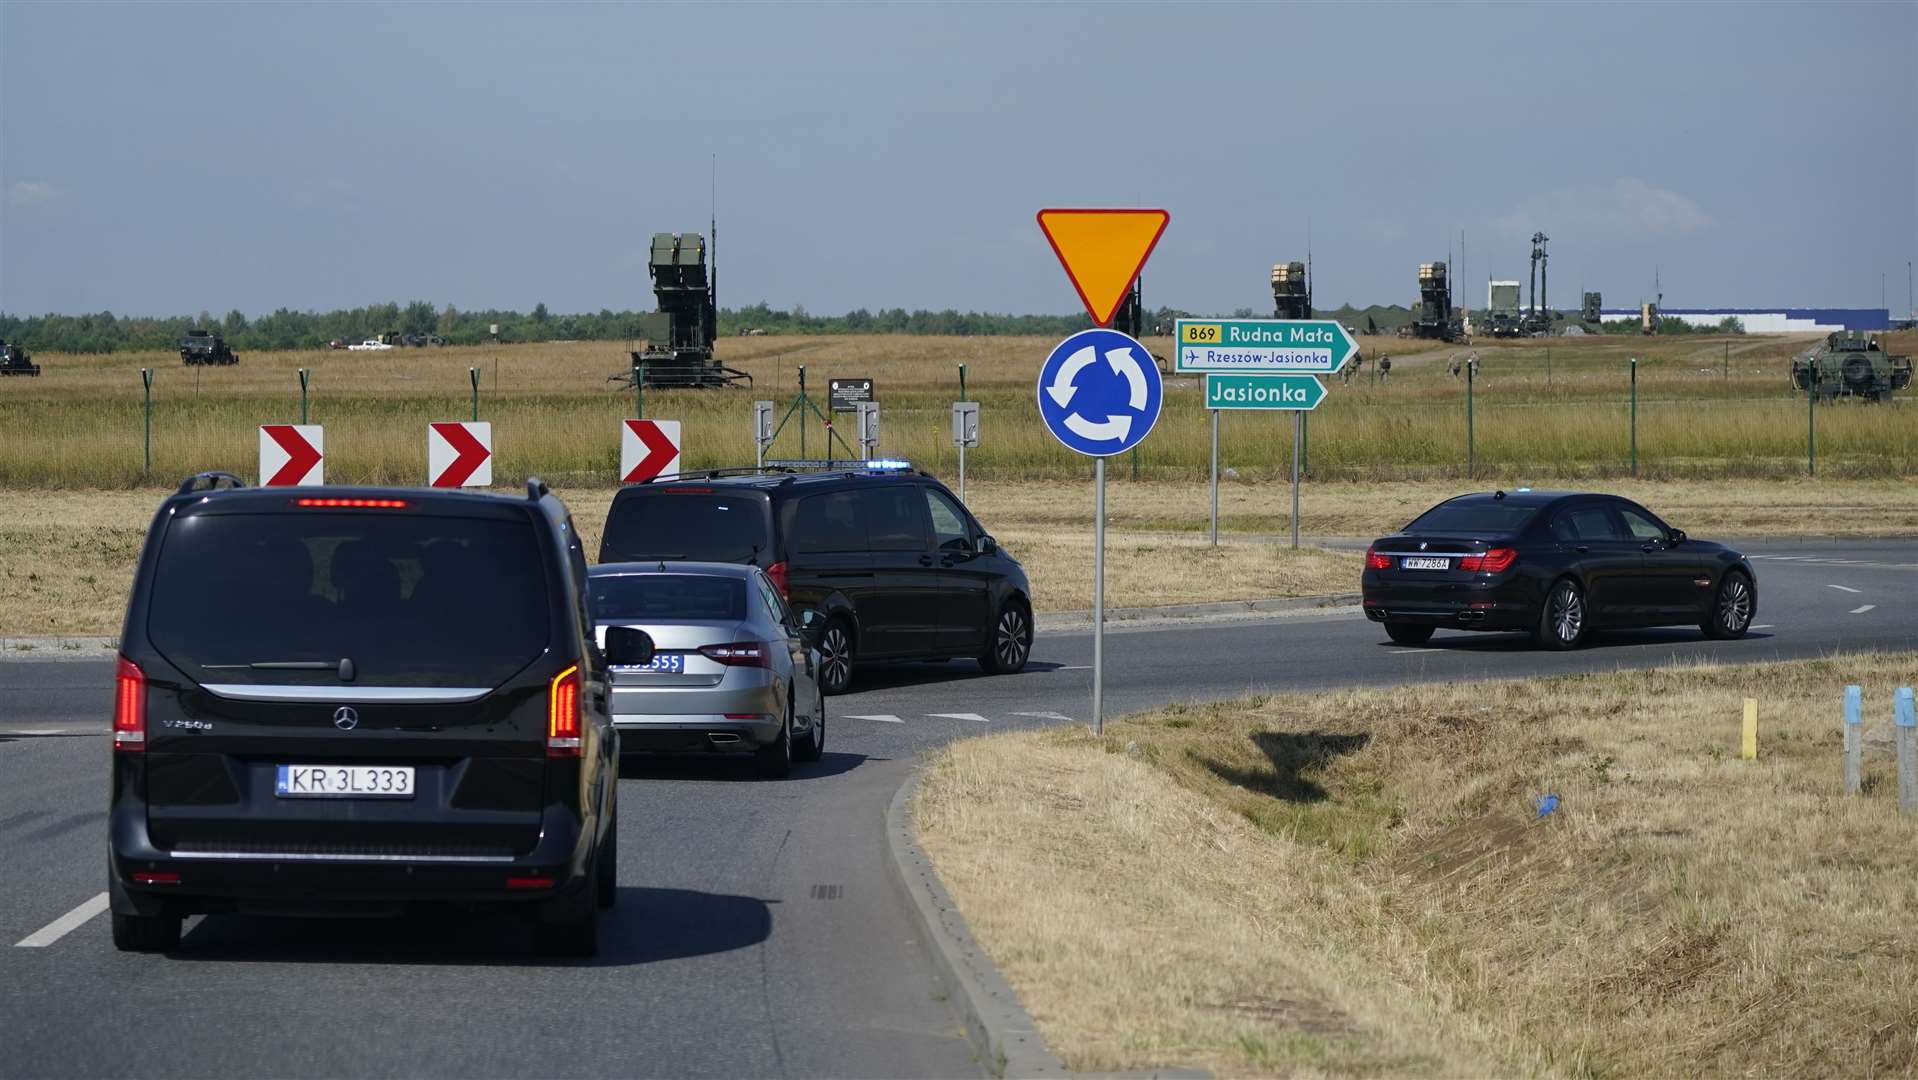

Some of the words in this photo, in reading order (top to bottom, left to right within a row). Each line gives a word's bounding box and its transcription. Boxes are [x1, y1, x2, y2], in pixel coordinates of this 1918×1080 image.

[1190, 327, 1215, 341] 869
[1230, 327, 1282, 342] Rudna
[1290, 327, 1333, 343] Mała
[1207, 350, 1328, 364] Rzeszów-Jasionka
[1212, 382, 1306, 401] Jasionka
[293, 769, 326, 791] KR
[337, 769, 407, 792] 3L333
